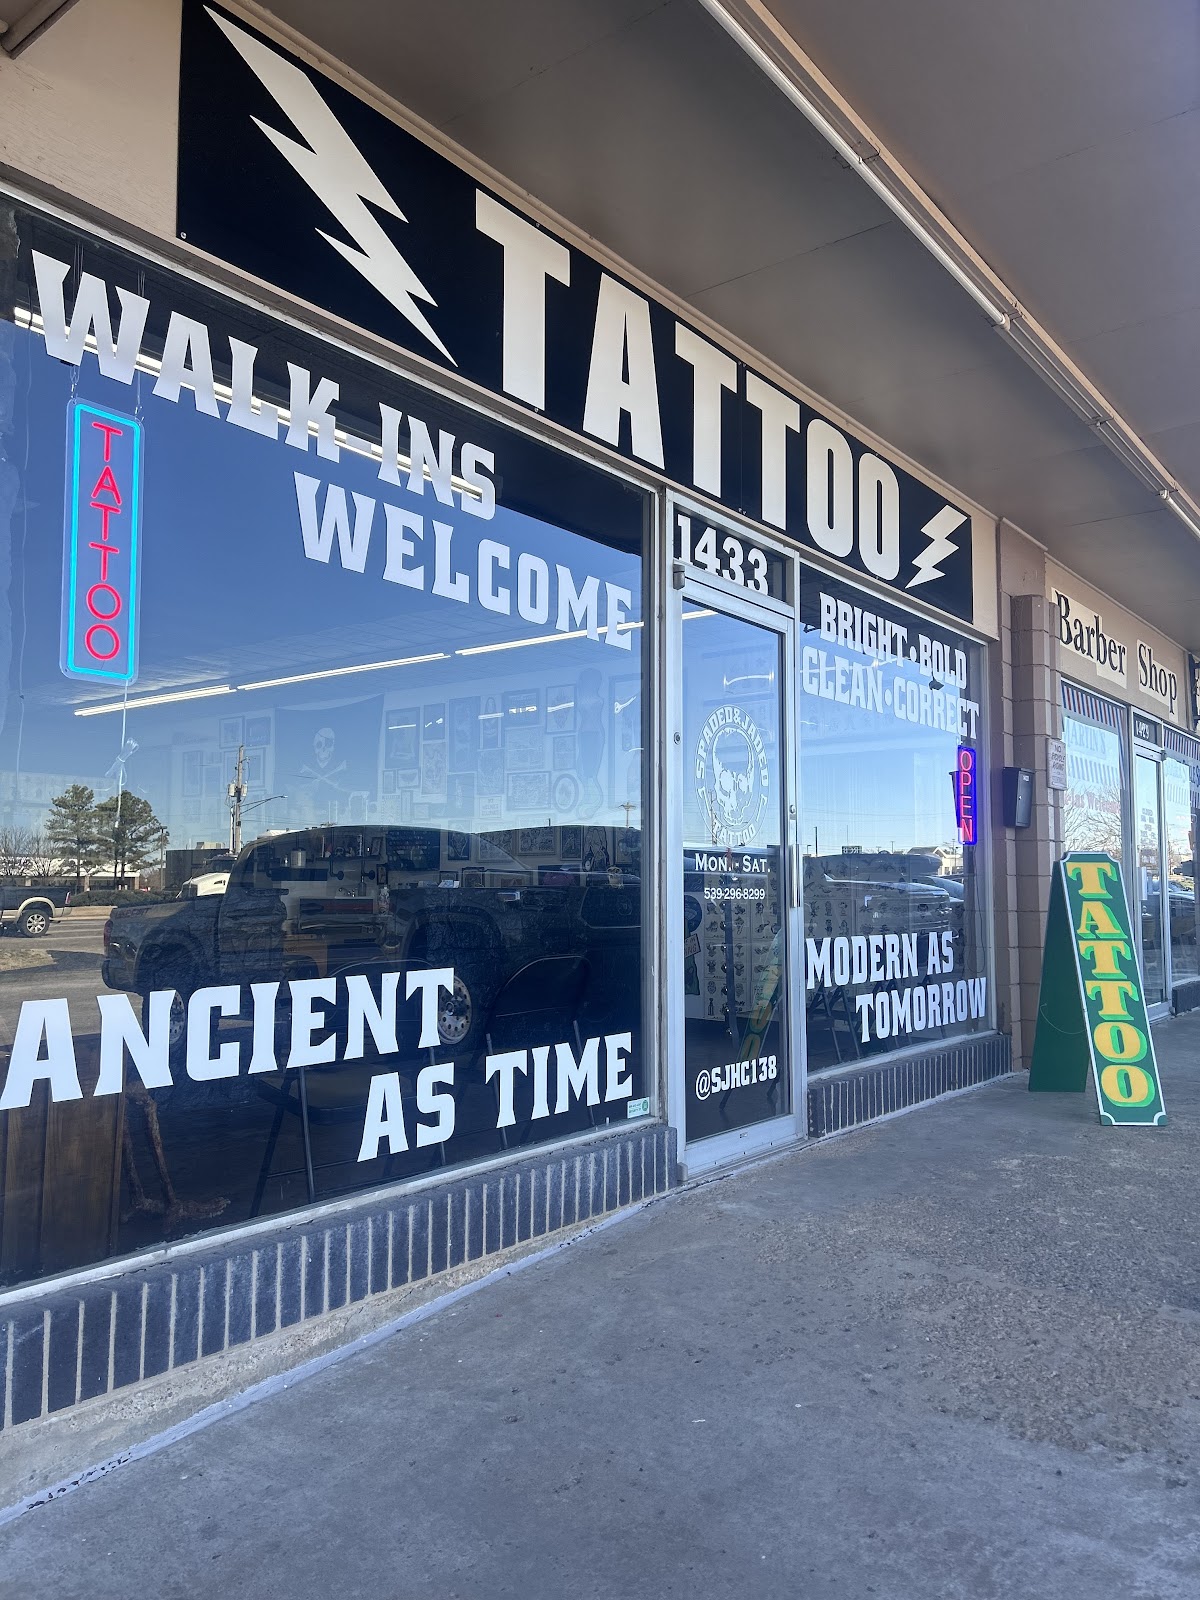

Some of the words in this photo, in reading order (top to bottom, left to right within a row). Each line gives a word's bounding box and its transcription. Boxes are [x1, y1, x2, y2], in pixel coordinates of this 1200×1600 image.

[476, 188, 899, 581] TATTOO
[85, 421, 123, 661] TATTOO
[294, 471, 632, 650] WELCOME
[677, 514, 769, 596] 1433
[1054, 590, 1127, 676] Barber
[1138, 642, 1178, 715] Shop
[712, 819, 757, 846] TATTOO
[958, 750, 973, 842] OPEN
[704, 887, 766, 900] 539-296-8299
[806, 932, 919, 990] MODERN
[926, 931, 955, 977] AS
[856, 976, 987, 1044] TOMORROW
[1066, 861, 1156, 1108] TATTOO
[0, 967, 454, 1110] ANCIENT
[695, 1054, 778, 1100] @SJHC138
[357, 1062, 456, 1163] AS
[485, 1032, 633, 1128] TIME
